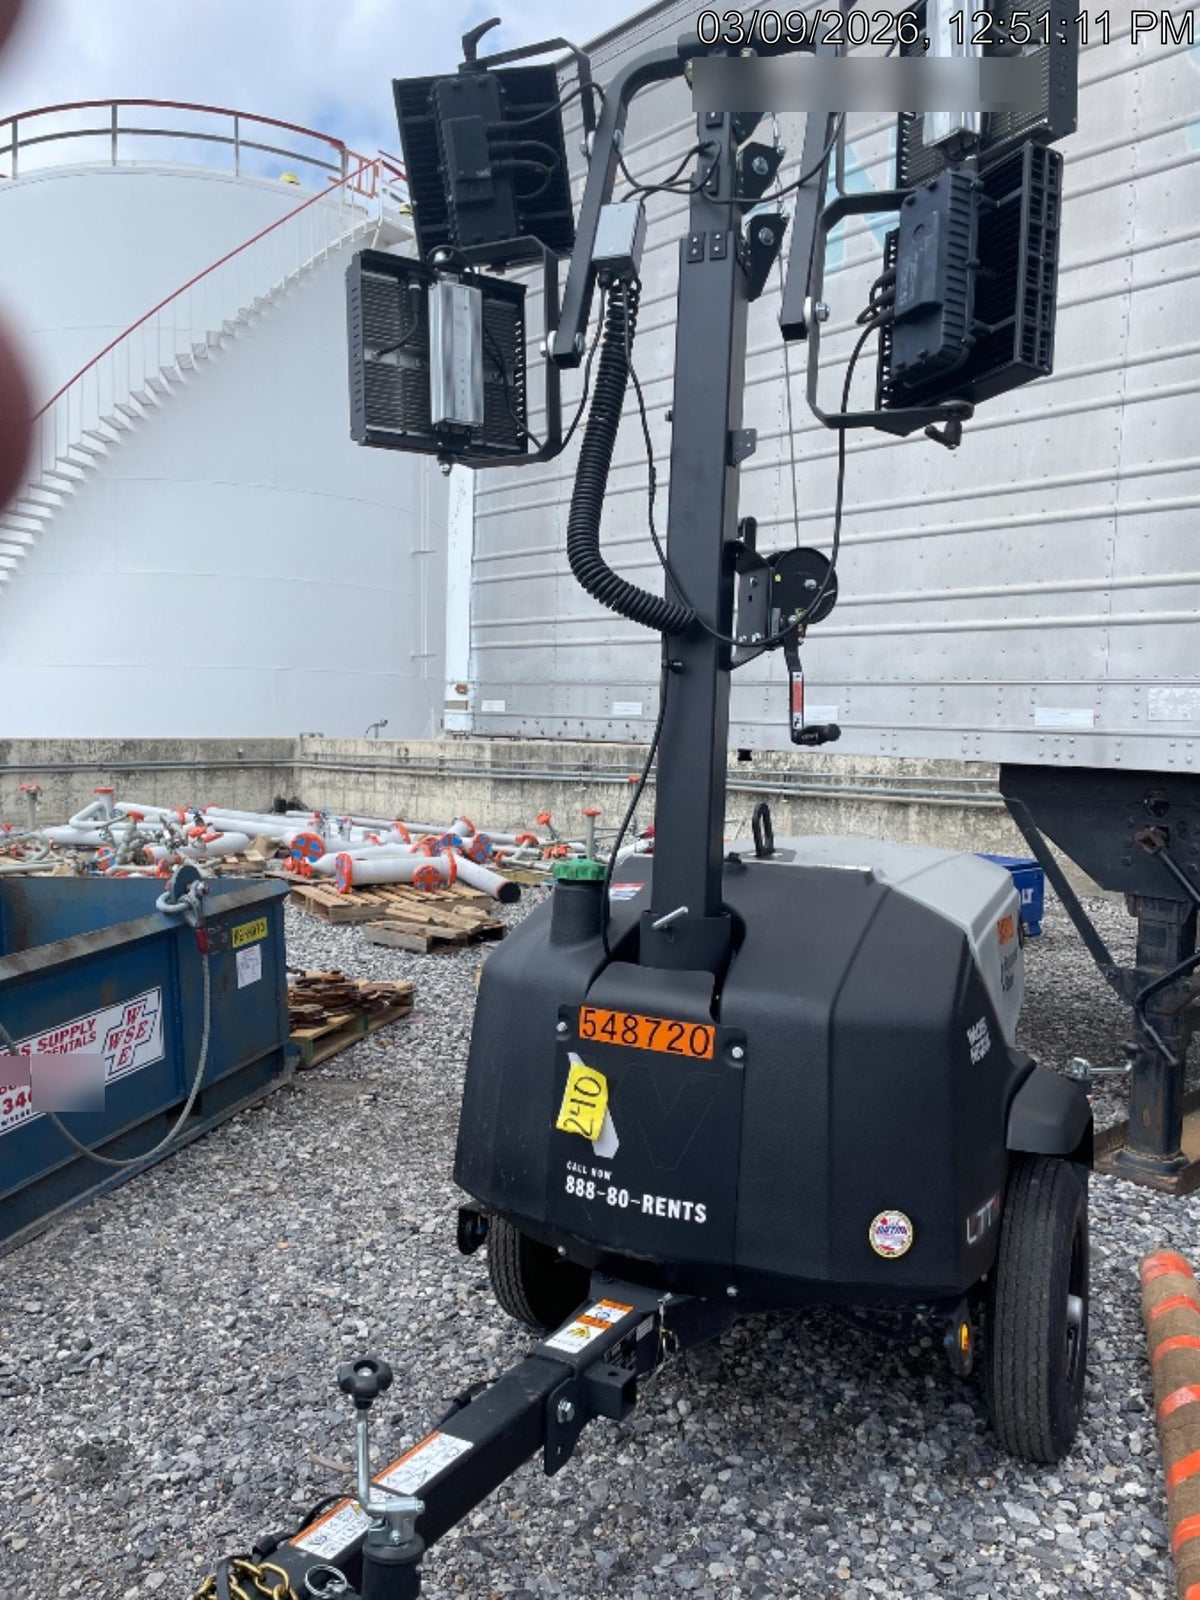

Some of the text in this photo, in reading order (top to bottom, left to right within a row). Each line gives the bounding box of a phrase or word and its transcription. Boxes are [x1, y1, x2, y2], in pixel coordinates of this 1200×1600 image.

[37, 1018, 97, 1052] SUPPLY
[108, 1019, 149, 1051] WSE
[582, 1009, 710, 1057] 548720
[563, 1076, 602, 1137] 240
[566, 1160, 612, 1181] CALL NOW
[565, 1175, 707, 1224] 888-80-RENTS
